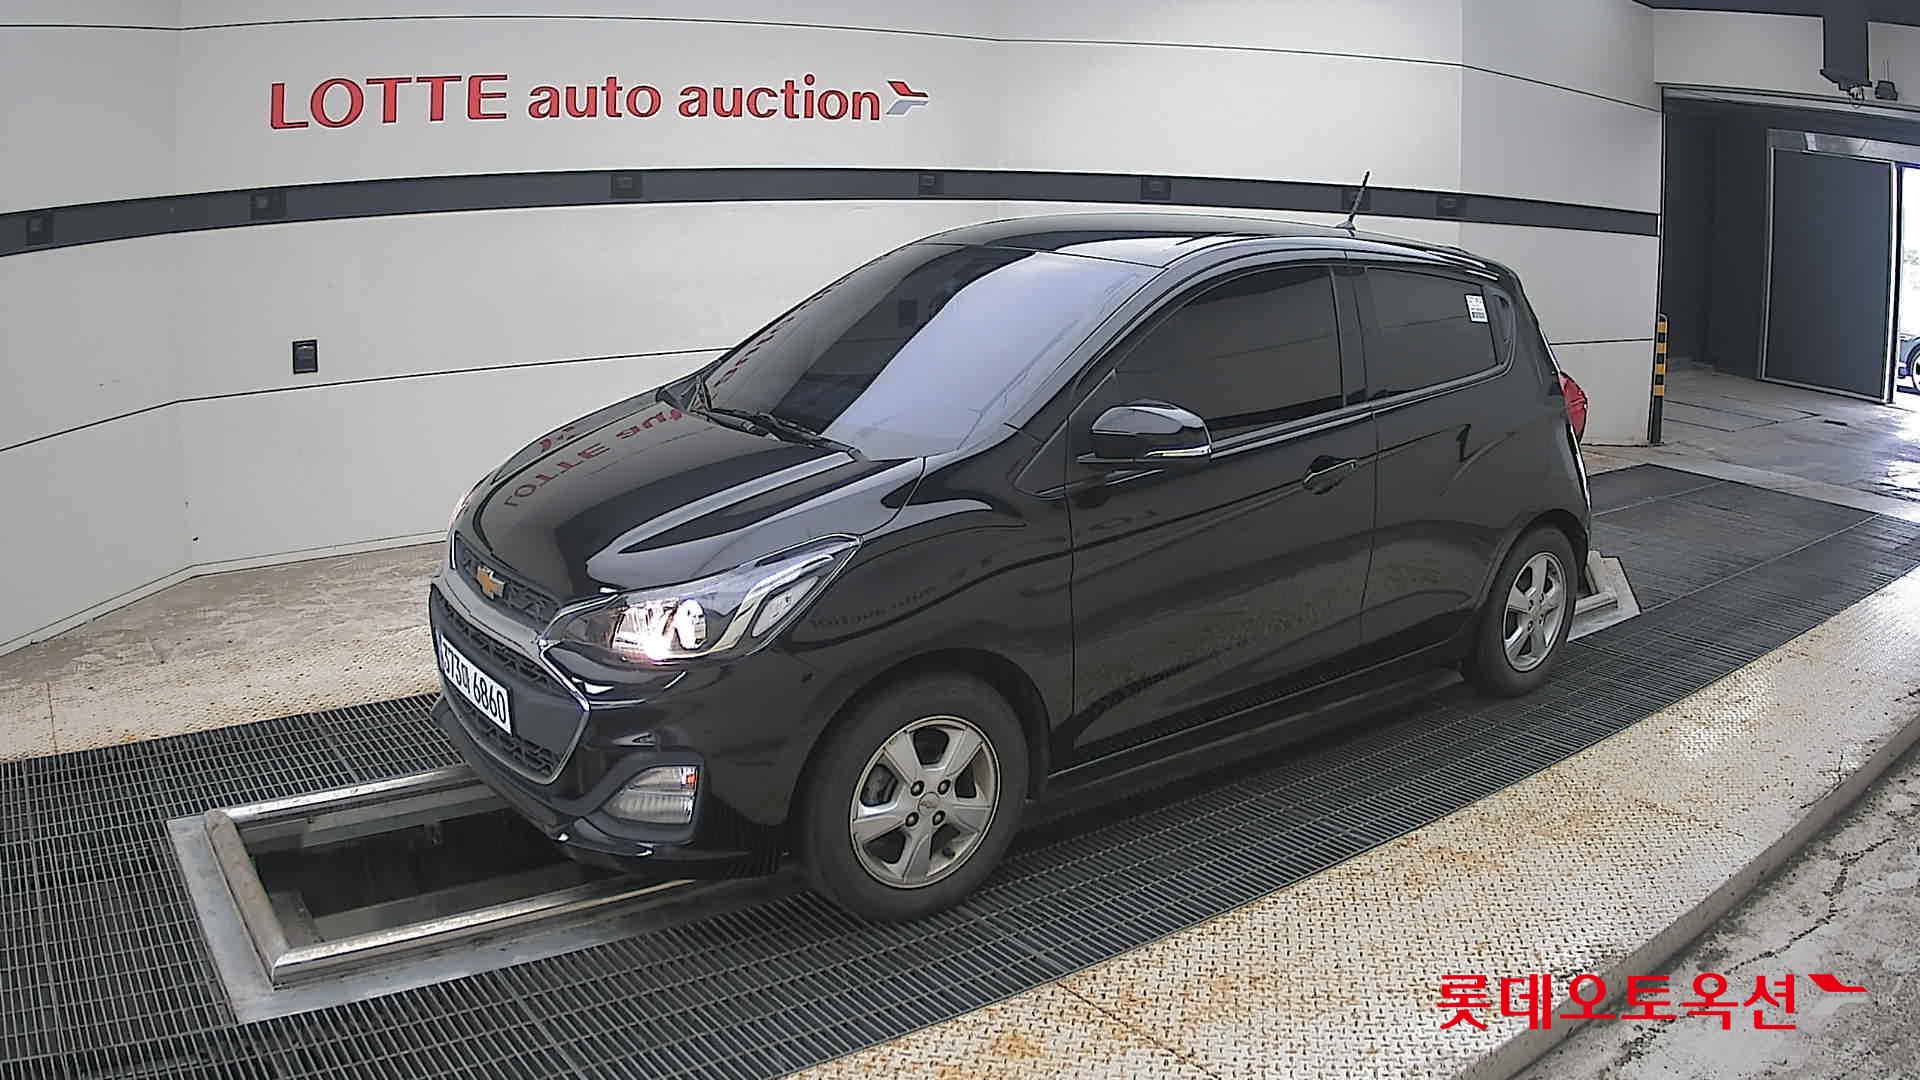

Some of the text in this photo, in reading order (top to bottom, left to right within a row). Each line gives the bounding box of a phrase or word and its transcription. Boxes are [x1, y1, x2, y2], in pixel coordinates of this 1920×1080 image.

[271, 73, 881, 130] LOTTE auto auction
[473, 671, 507, 725] 6860
